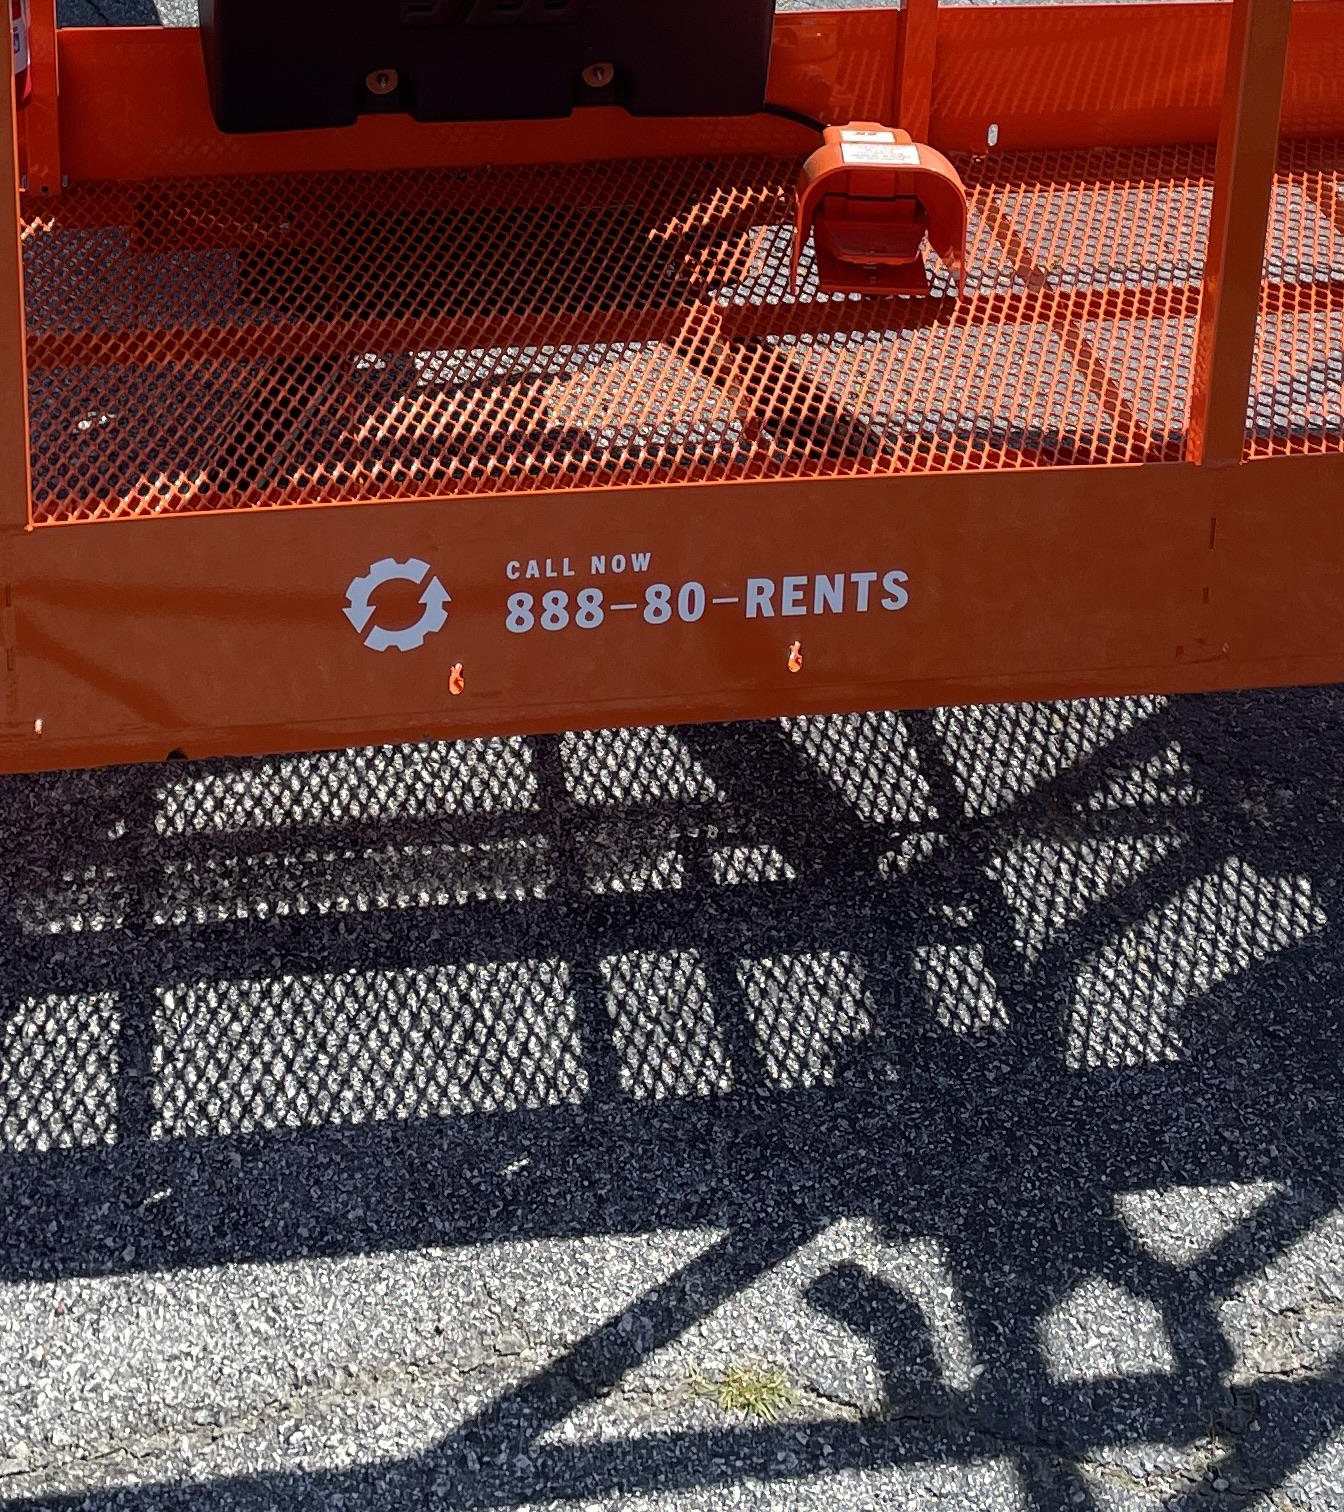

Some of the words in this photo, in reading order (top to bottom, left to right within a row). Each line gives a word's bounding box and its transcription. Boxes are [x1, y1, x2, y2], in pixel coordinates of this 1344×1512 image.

[506, 556, 576, 581] CALL
[590, 552, 652, 575] NOW
[504, 570, 909, 634] 888-80-RENTS
